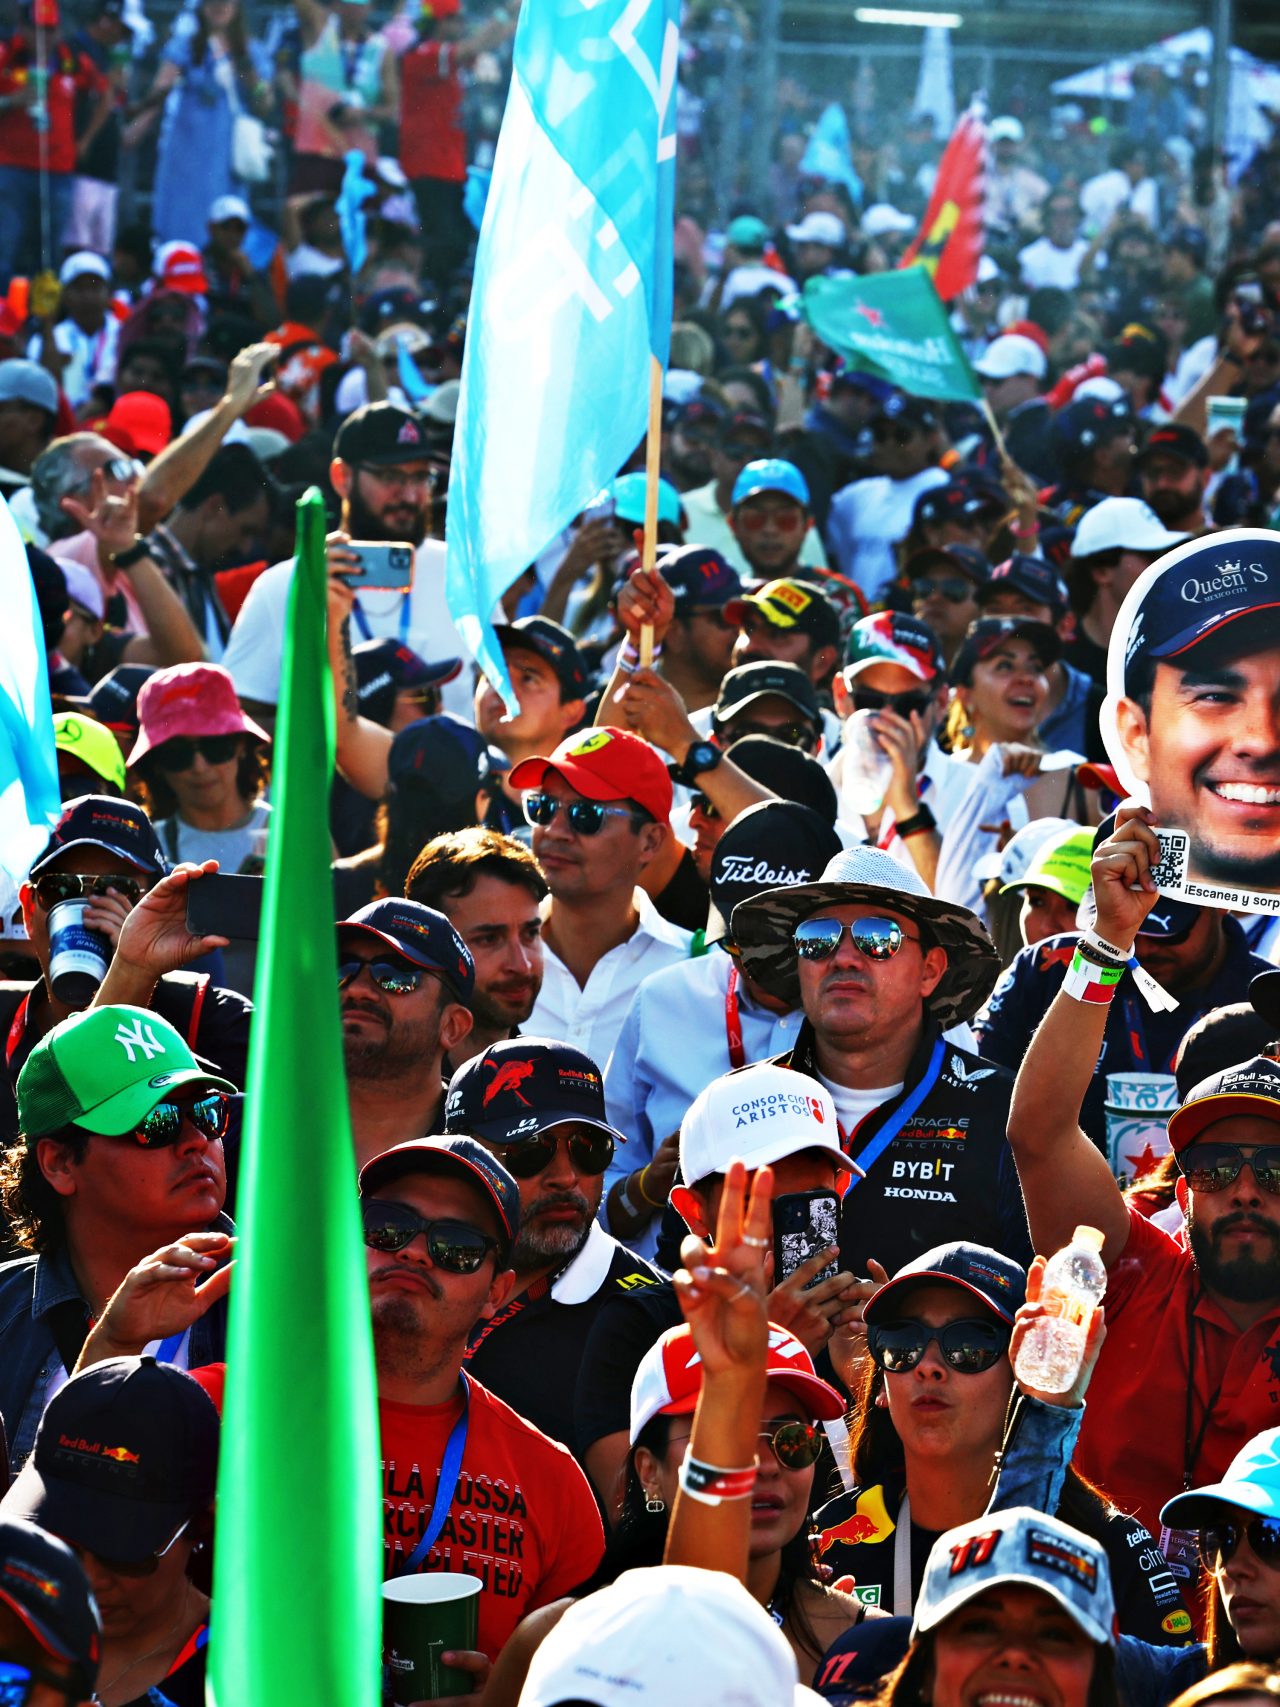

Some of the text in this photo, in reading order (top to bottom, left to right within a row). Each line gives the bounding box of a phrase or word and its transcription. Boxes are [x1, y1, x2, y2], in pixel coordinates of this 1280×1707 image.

[1204, 587, 1248, 602] MEXICO CITY
[715, 856, 811, 885] Titleist
[1184, 884, 1239, 903] ¡Escanea
[1242, 896, 1250, 907] y
[114, 1018, 166, 1062] NY
[558, 1068, 583, 1080] Red Bull
[1221, 1073, 1256, 1086] Red Bull
[732, 1094, 806, 1116] CONSORCIO
[736, 1104, 810, 1128] ARISTOS
[506, 1123, 540, 1137] UNIFIN
[916, 1129, 935, 1138] Bull
[891, 1141, 965, 1151] RACING
[892, 1158, 955, 1181] BYBIT
[883, 1187, 957, 1203] HONDA
[463, 1301, 526, 1359] Red Bull
[58, 1434, 101, 1454] Red Bull
[949, 1530, 1004, 1579] 11
[1032, 1531, 1095, 1566] ORACLE
[818, 1651, 860, 1688] 11
